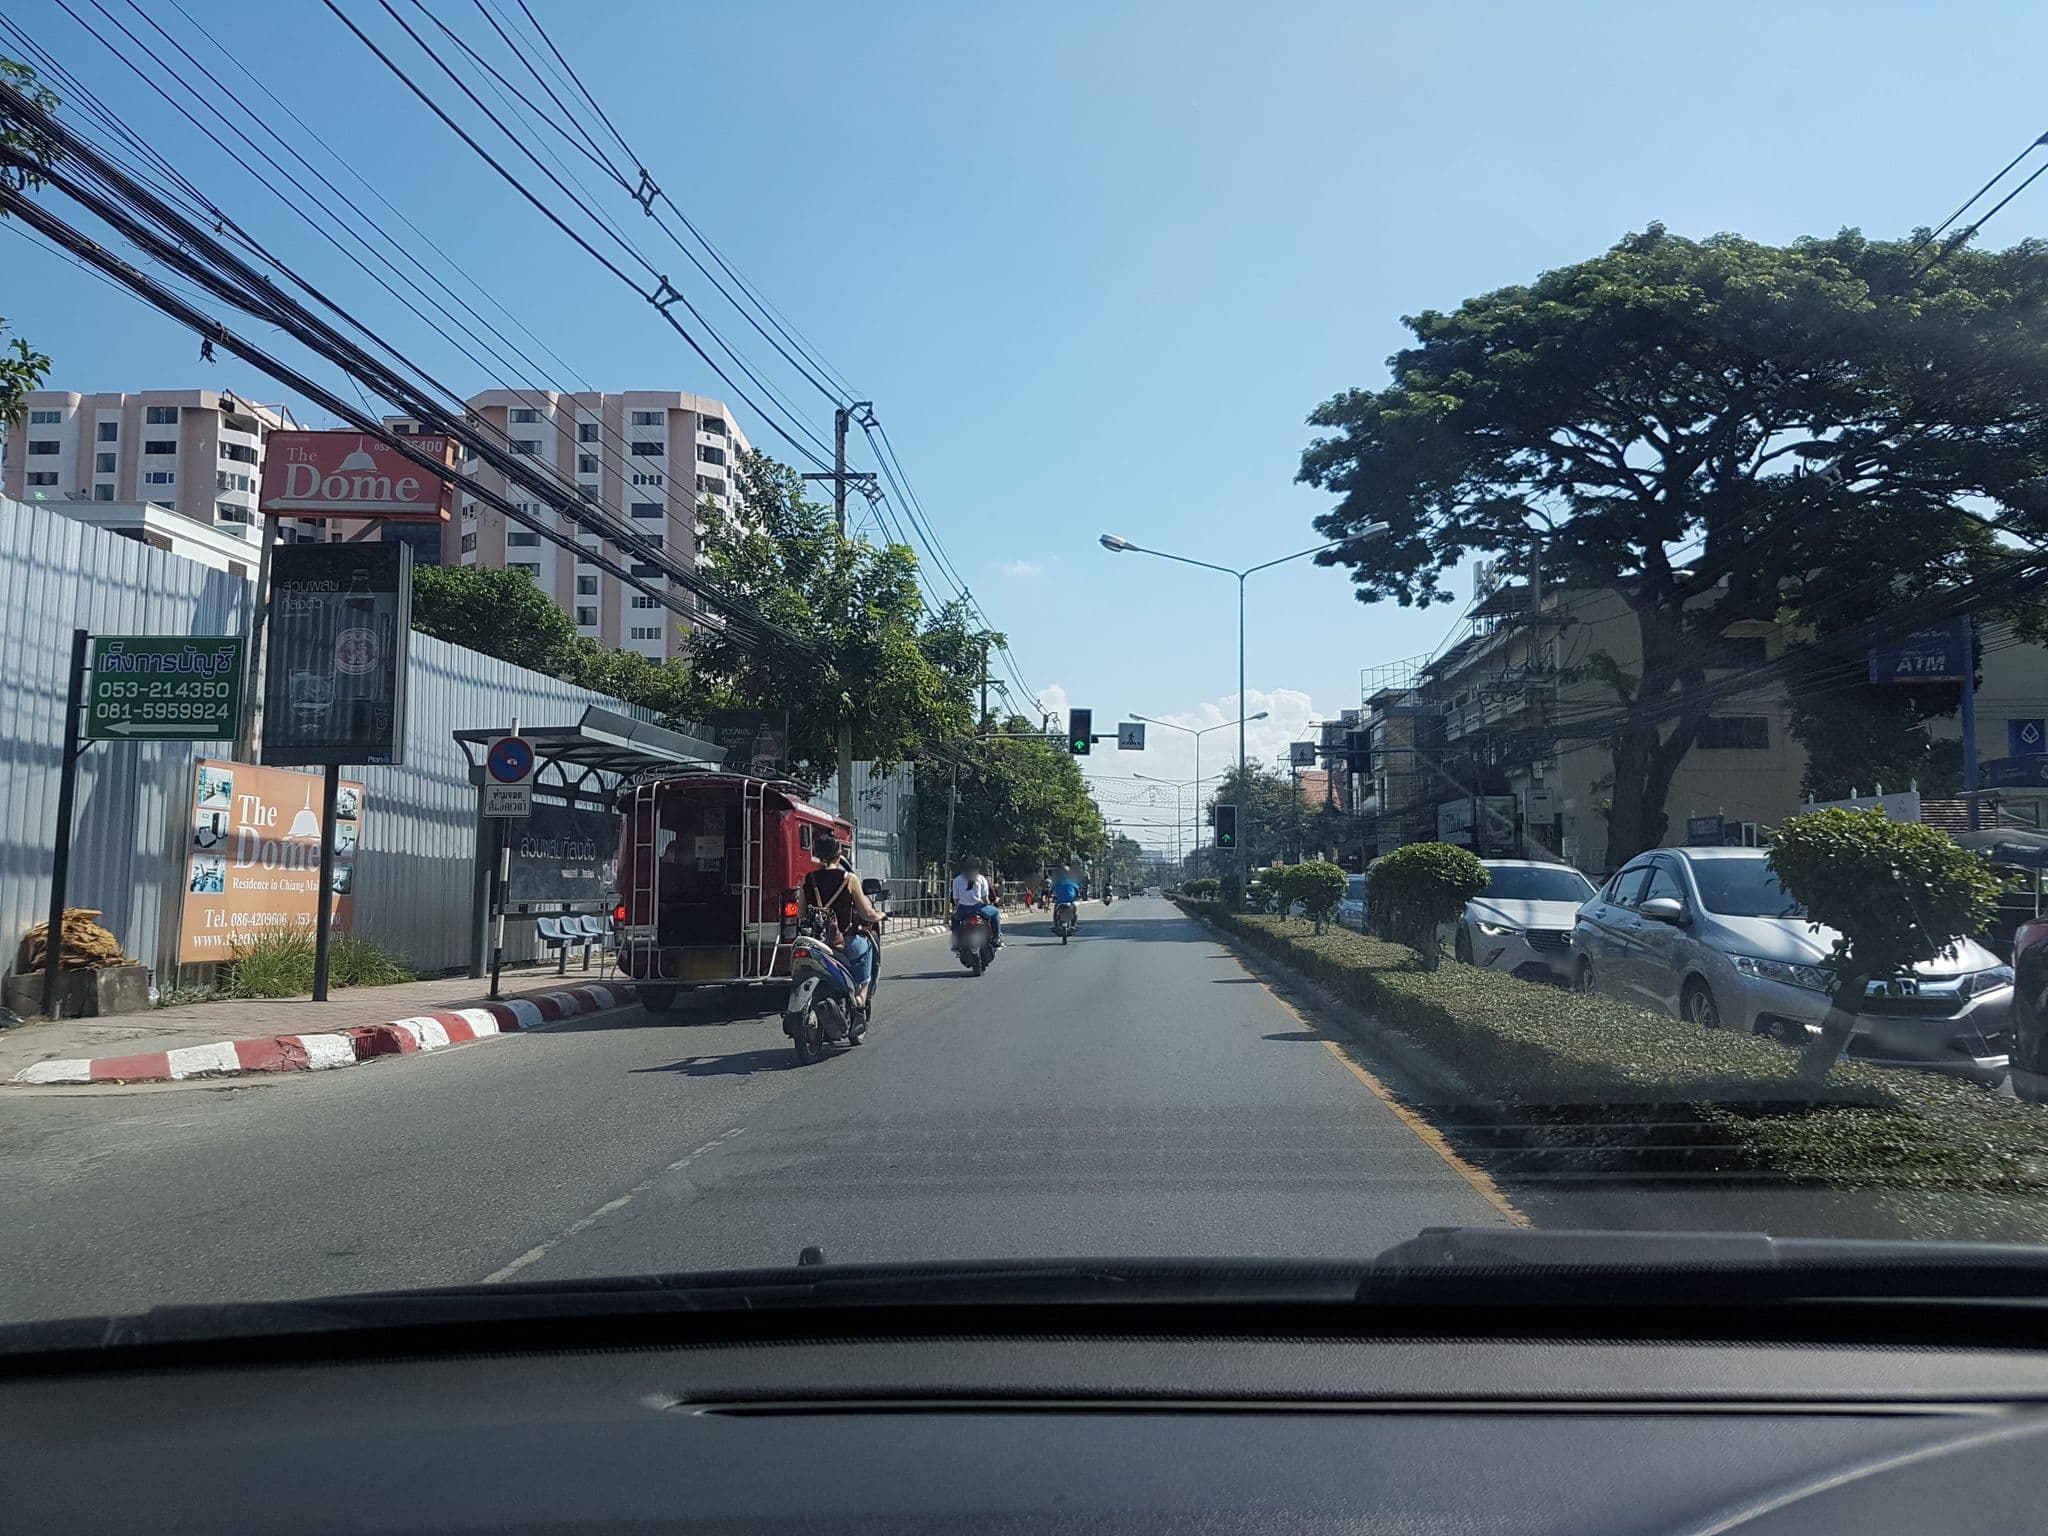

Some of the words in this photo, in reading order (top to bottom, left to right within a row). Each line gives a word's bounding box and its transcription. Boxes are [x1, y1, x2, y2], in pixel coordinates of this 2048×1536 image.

[287, 447, 318, 462] The
[281, 464, 420, 501] Dome
[99, 642, 235, 679] เต็งการบัญชี
[1896, 656, 1946, 672] ATM
[99, 682, 230, 698] 053-214350
[96, 703, 230, 719] 081-5959924
[493, 789, 522, 800] ห้ามจอด
[238, 794, 278, 827] The
[232, 825, 321, 872] Dome
[232, 878, 271, 891] Residence
[271, 878, 278, 890] in
[279, 879, 305, 892] Chiang
[205, 909, 228, 927] Tel.
